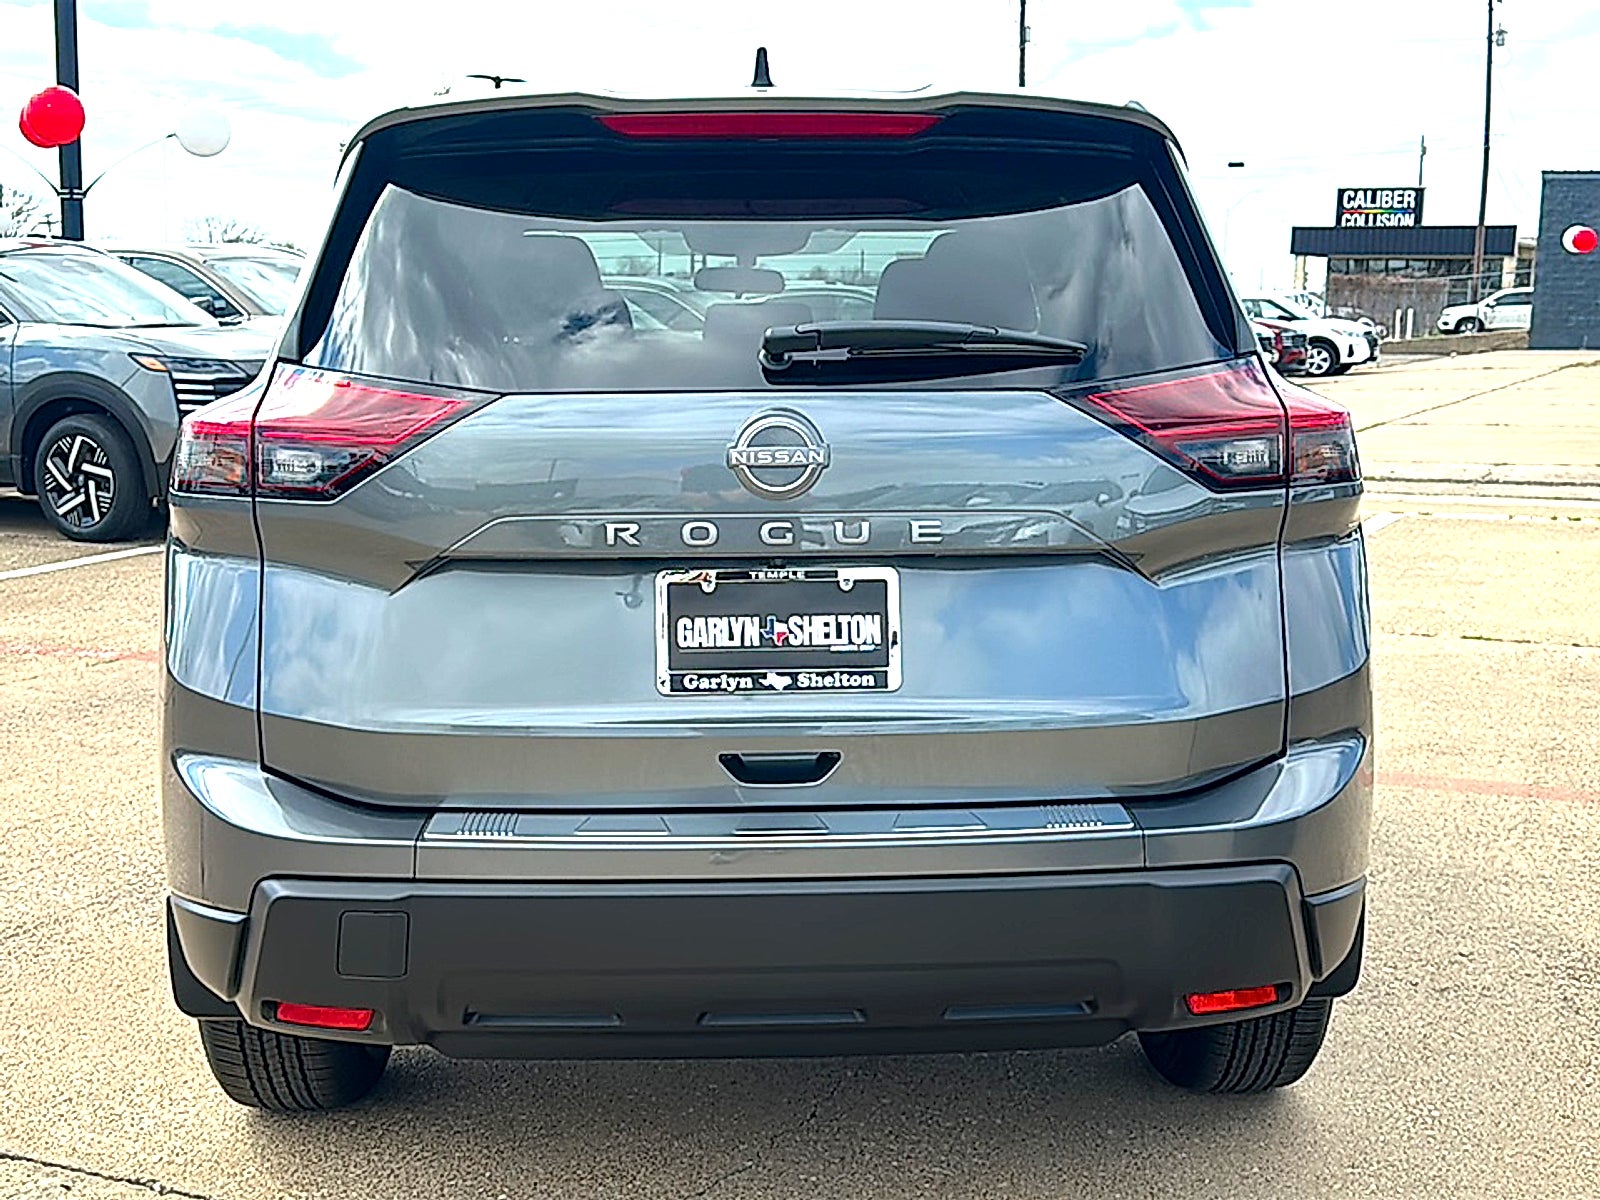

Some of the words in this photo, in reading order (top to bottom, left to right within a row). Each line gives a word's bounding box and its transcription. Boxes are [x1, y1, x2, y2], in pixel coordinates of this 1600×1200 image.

[1343, 190, 1416, 209] CALIBER
[731, 450, 825, 466] NISSAN
[604, 520, 944, 547] ROGUE
[749, 570, 806, 580] TEMPLE
[677, 617, 761, 648] GARLYN
[787, 615, 882, 646] SHELTON
[683, 673, 754, 691] Garlyn
[796, 671, 875, 688] Shelton
